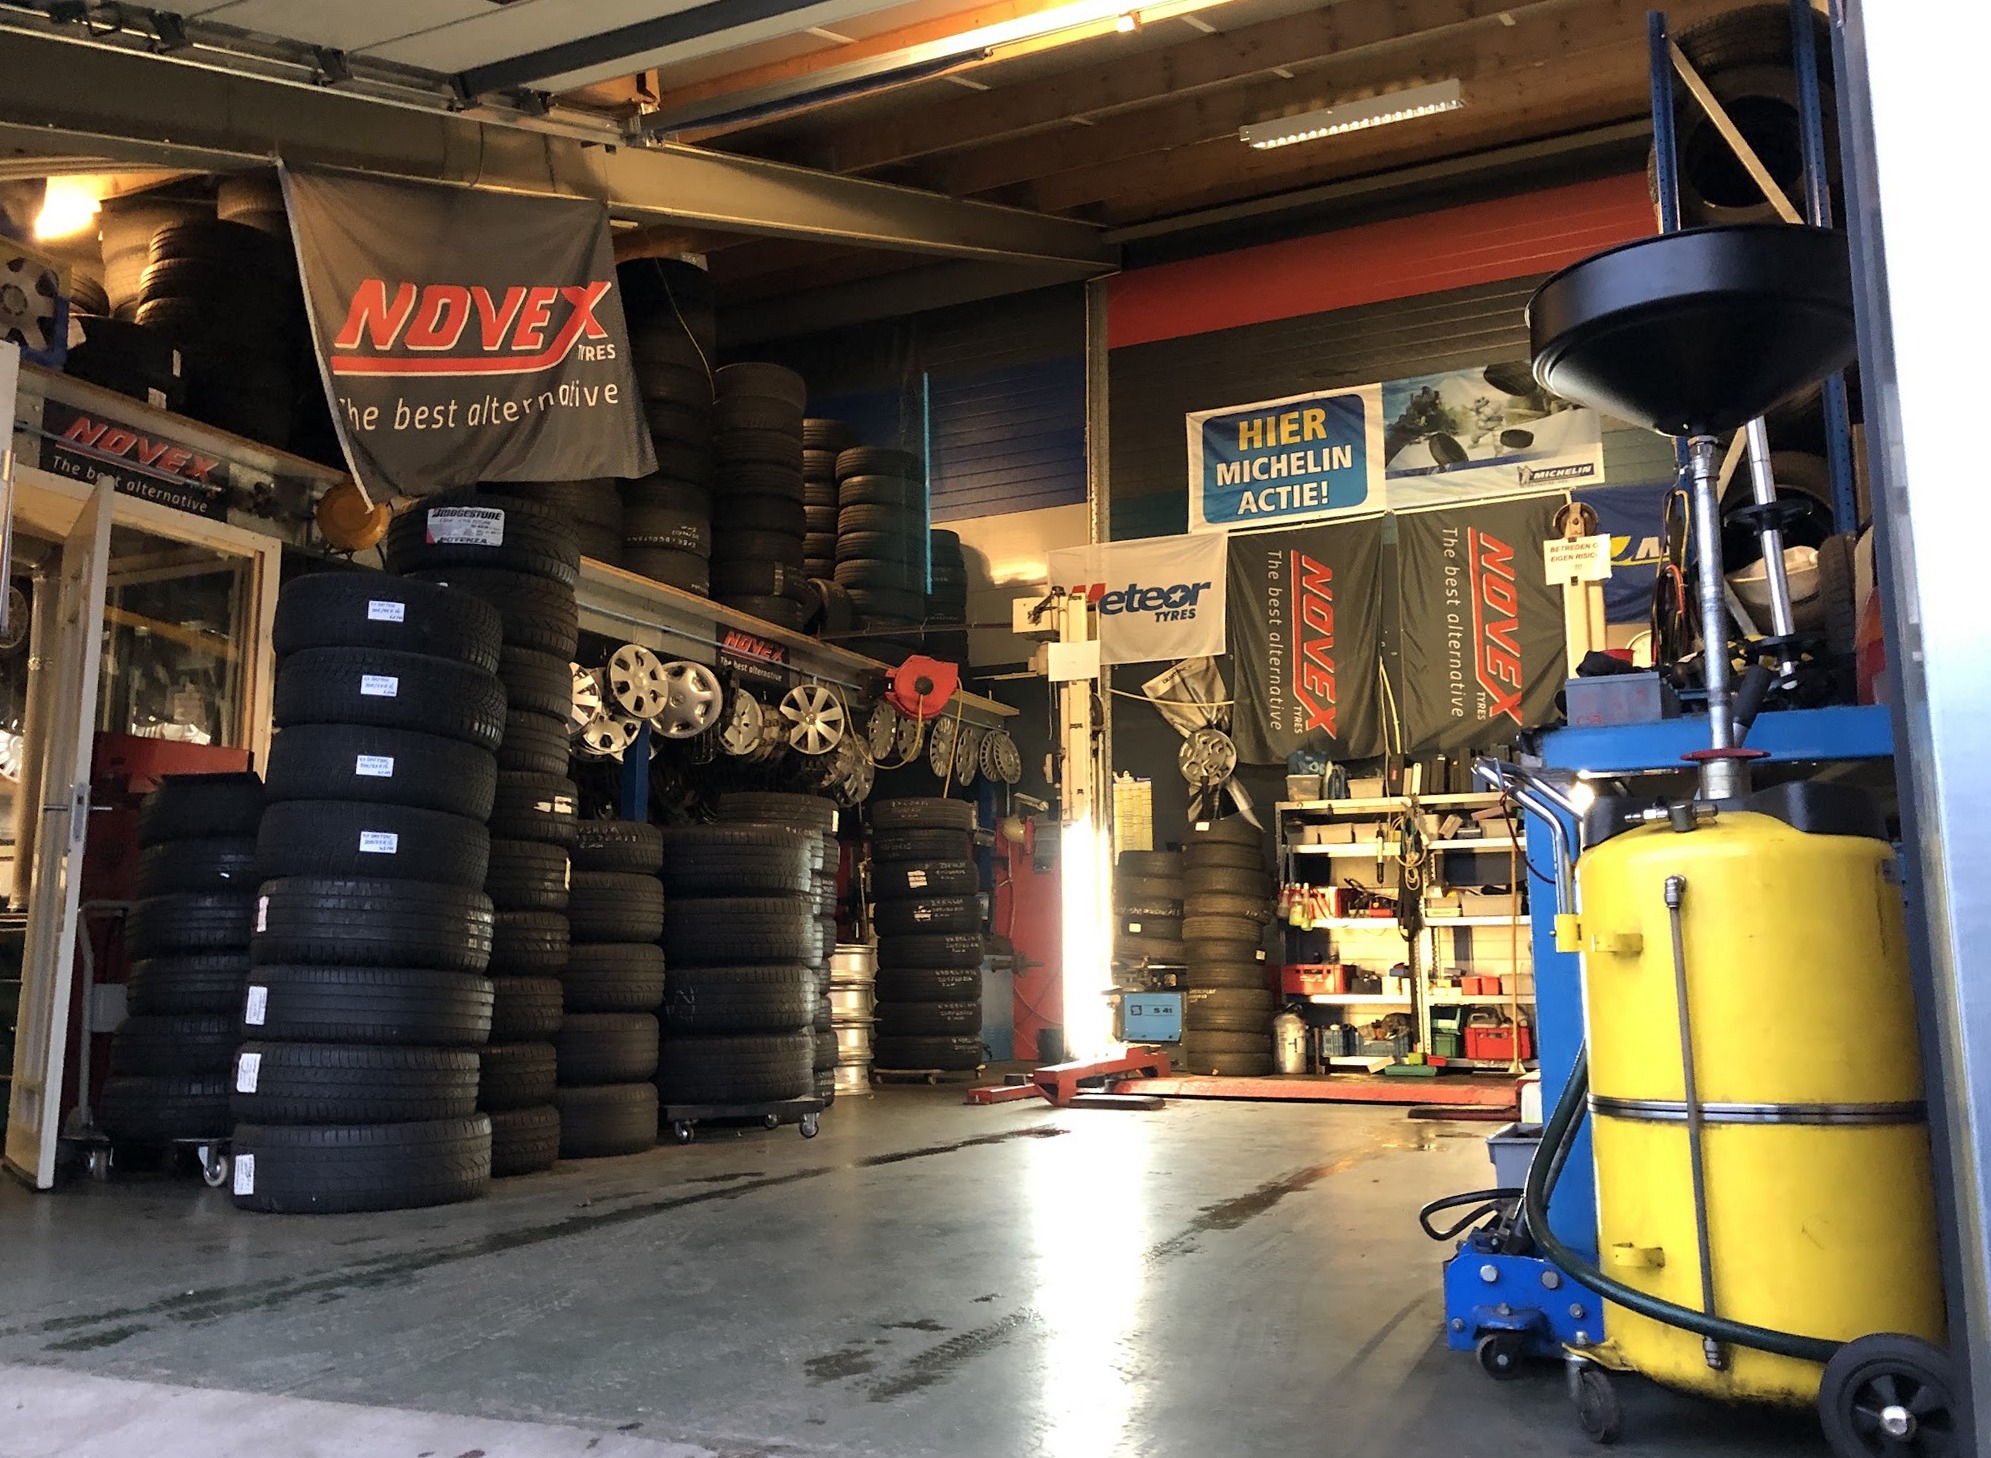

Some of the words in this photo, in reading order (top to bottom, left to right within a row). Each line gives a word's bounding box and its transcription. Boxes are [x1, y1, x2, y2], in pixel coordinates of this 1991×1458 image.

[334, 279, 612, 350] NOVEX
[394, 398, 458, 430] best
[467, 380, 618, 426] alternative
[62, 416, 219, 480] NOVEX
[1238, 408, 1327, 451] HIER
[53, 455, 80, 475] The
[127, 480, 208, 513] alternative
[1216, 444, 1353, 487] MICHELIN
[1533, 465, 1592, 480] MICHELIN
[1237, 481, 1329, 515] ACTIE!
[1442, 527, 1458, 558] The
[1550, 543, 1591, 553] BETREDEN
[1575, 552, 1598, 560] RISIC
[1267, 550, 1282, 580] The
[1444, 566, 1460, 606] best
[1155, 608, 1197, 622] TYRES
[1267, 588, 1282, 625] best
[724, 630, 784, 662] NOVEX
[1302, 554, 1337, 740] NOVEX
[1480, 532, 1523, 726] NOVEX
[733, 661, 748, 672] best
[1268, 632, 1283, 731] alternative
[1446, 613, 1466, 718] alternative
[1293, 705, 1302, 734] TYRES
[1476, 692, 1486, 720] TYRES
